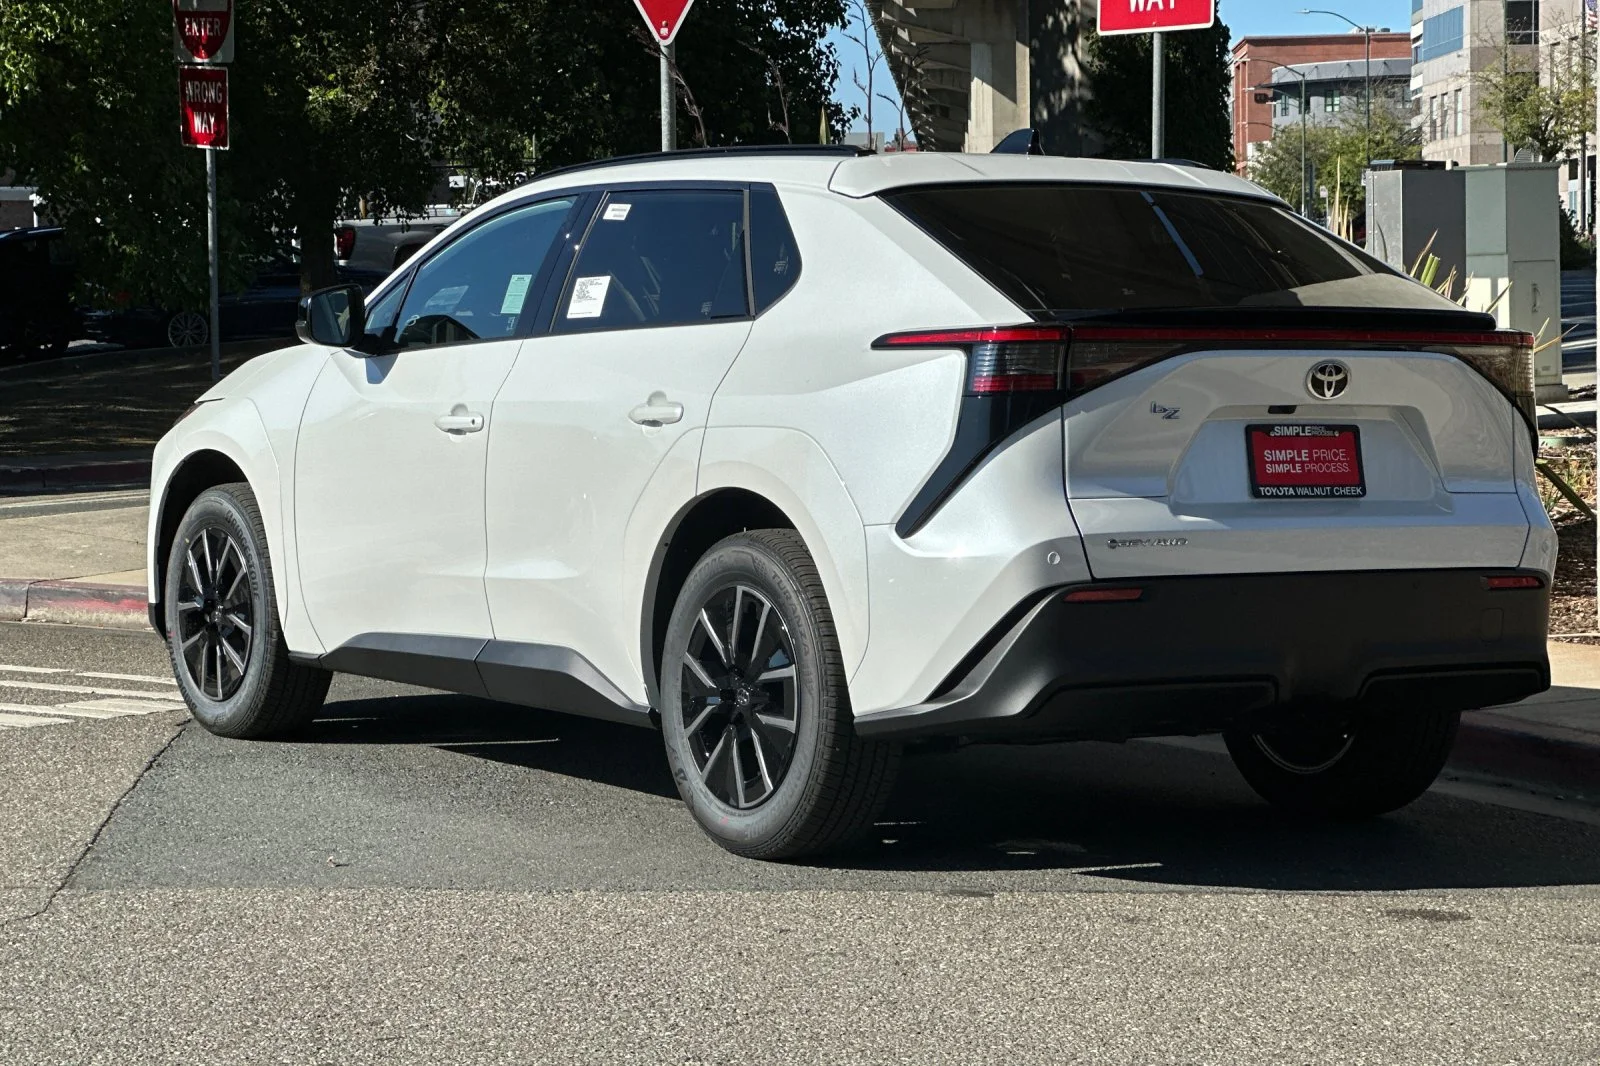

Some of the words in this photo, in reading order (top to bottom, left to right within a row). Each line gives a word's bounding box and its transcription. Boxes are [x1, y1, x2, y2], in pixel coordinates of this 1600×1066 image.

[185, 17, 221, 36] ENTER
[185, 81, 222, 103] WRONG
[193, 112, 215, 134] WAY
[1274, 425, 1312, 436] SIMPLE
[1264, 450, 1309, 462] SIMPLE
[1312, 449, 1350, 461] PRICE.
[1265, 463, 1302, 474] SIMPLE
[1304, 462, 1351, 473] PROCESS.
[1259, 487, 1296, 496] TOYOTA
[1295, 487, 1331, 496] WALNUT
